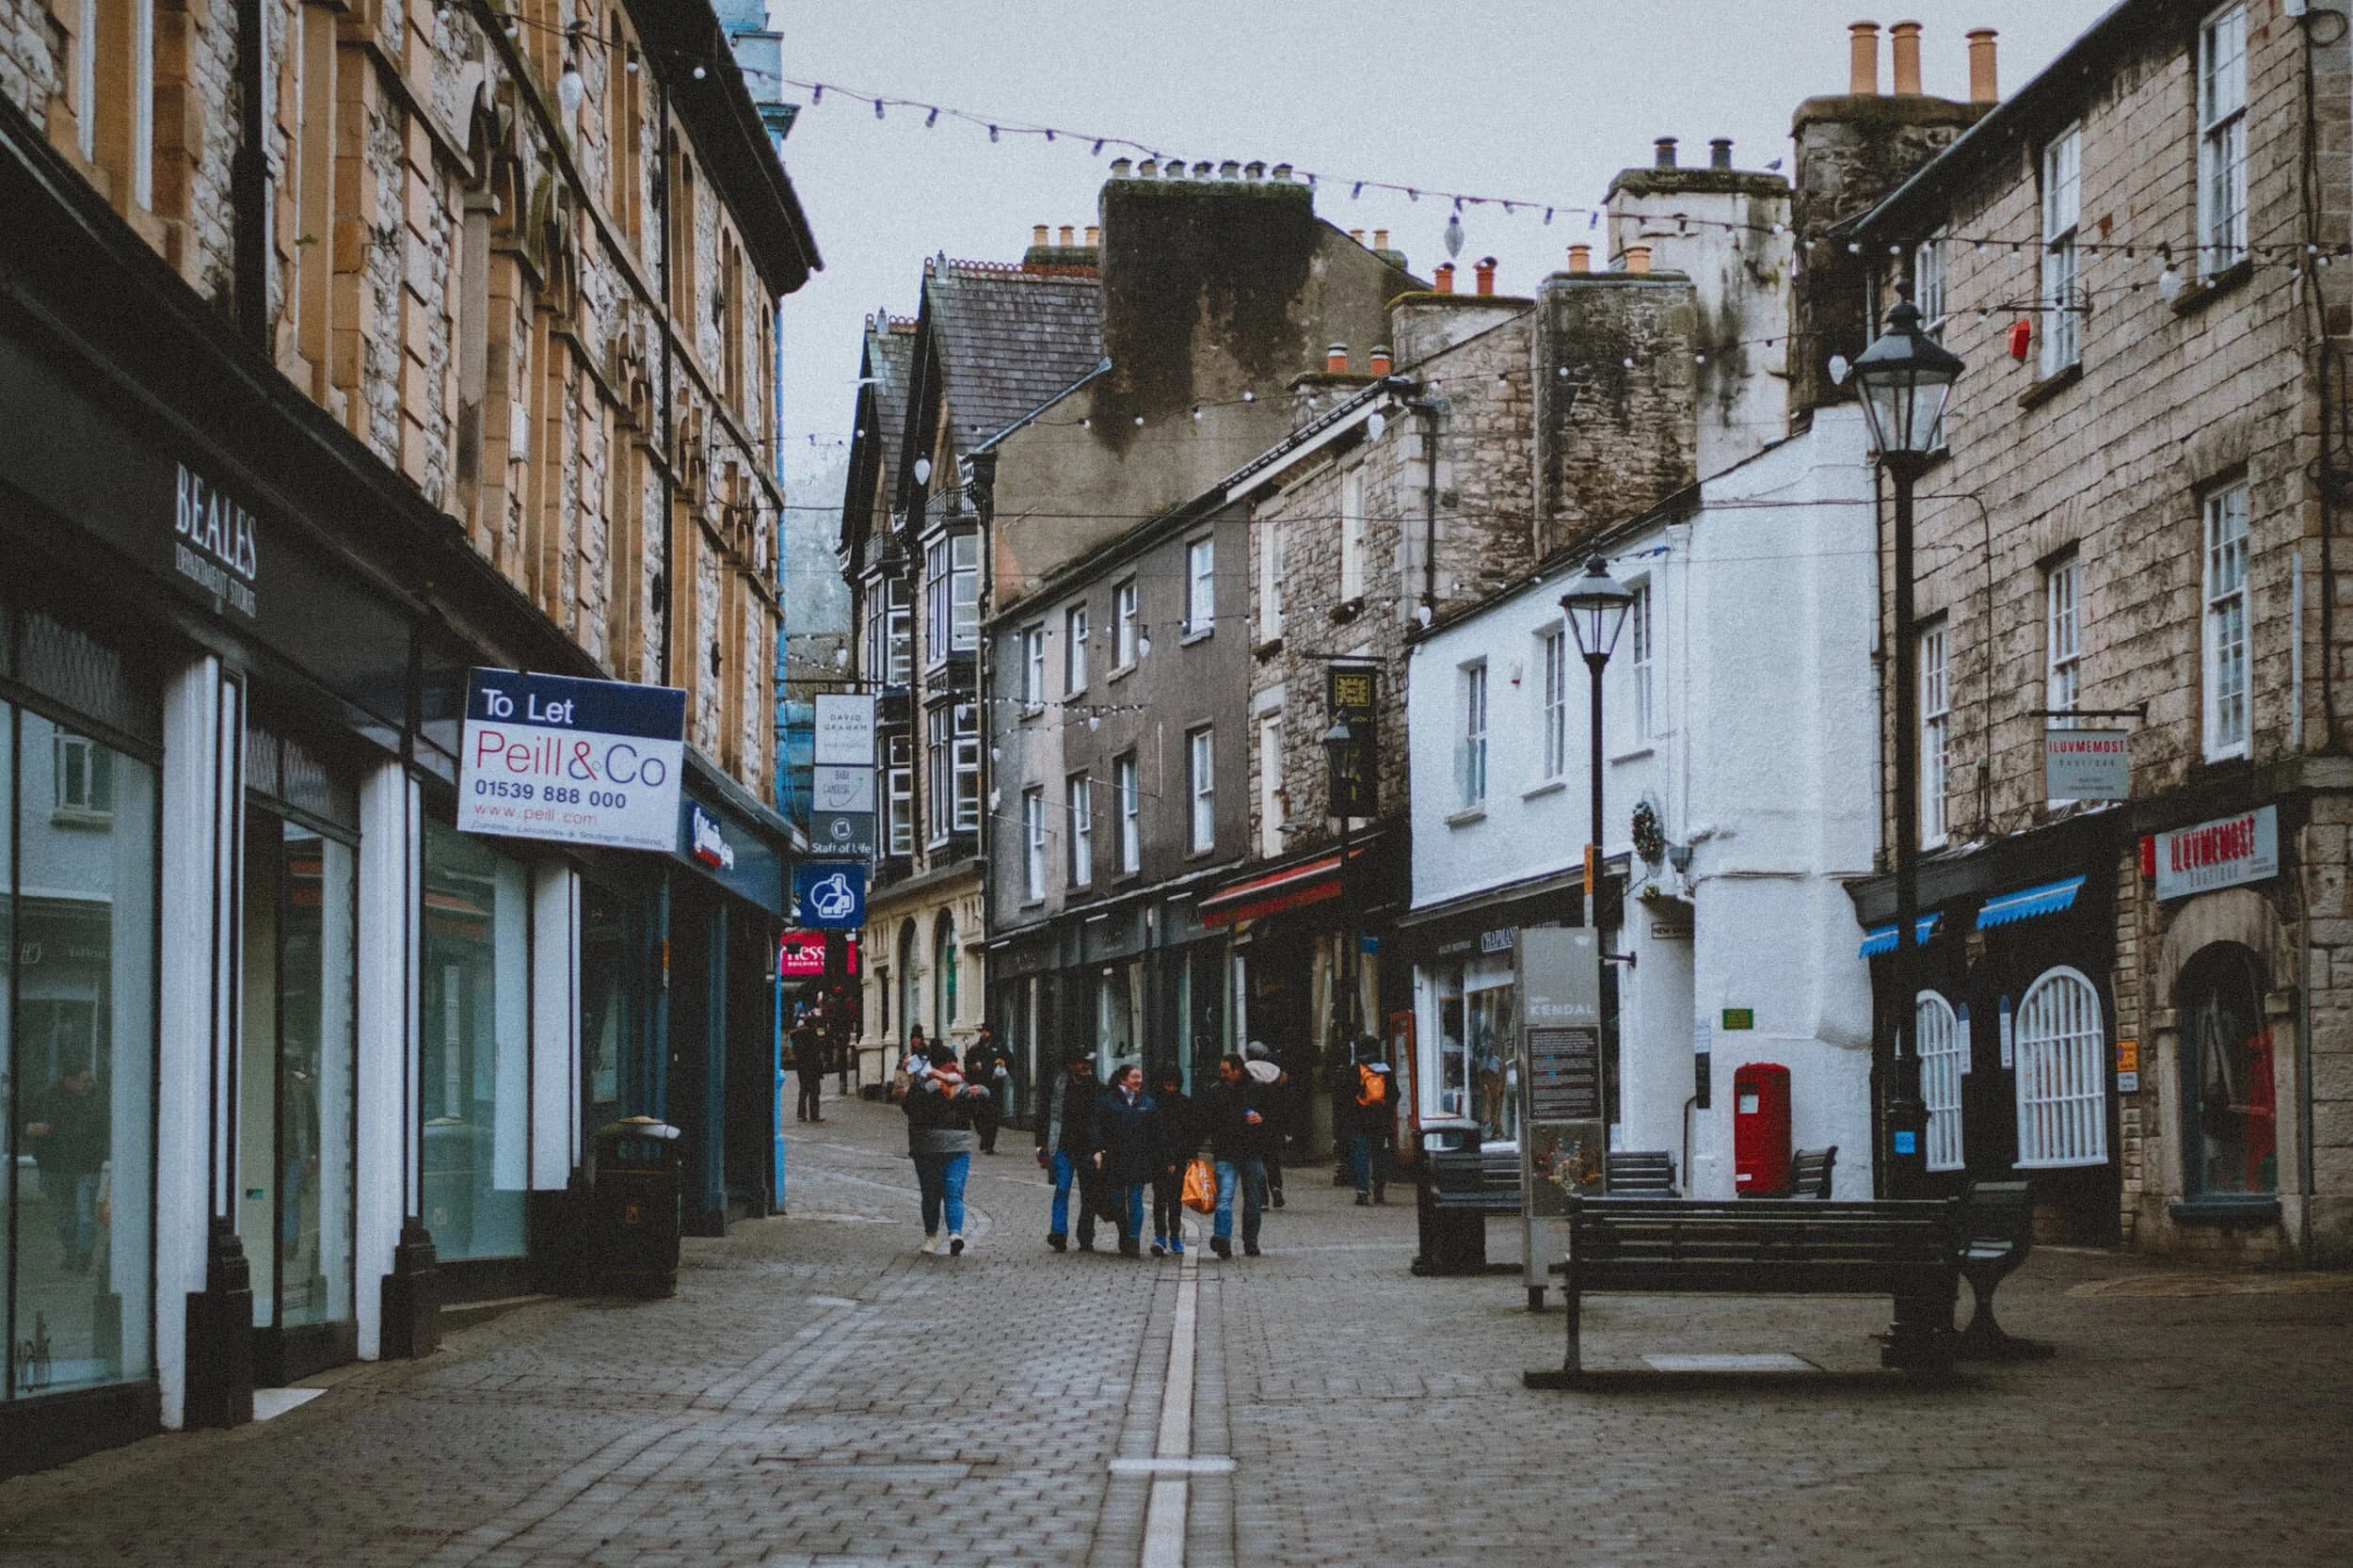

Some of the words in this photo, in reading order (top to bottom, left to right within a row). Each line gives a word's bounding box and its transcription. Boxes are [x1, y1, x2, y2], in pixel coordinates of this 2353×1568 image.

[174, 461, 257, 581] BEALES
[481, 688, 514, 718] To
[527, 694, 574, 725] Let
[474, 778, 535, 800] 01539
[542, 785, 581, 805] 888
[588, 790, 627, 809] 000
[812, 842, 836, 854] Staff
[838, 842, 851, 854] of
[852, 842, 872, 855] Life
[1529, 1003, 1596, 1016] KENDAL
